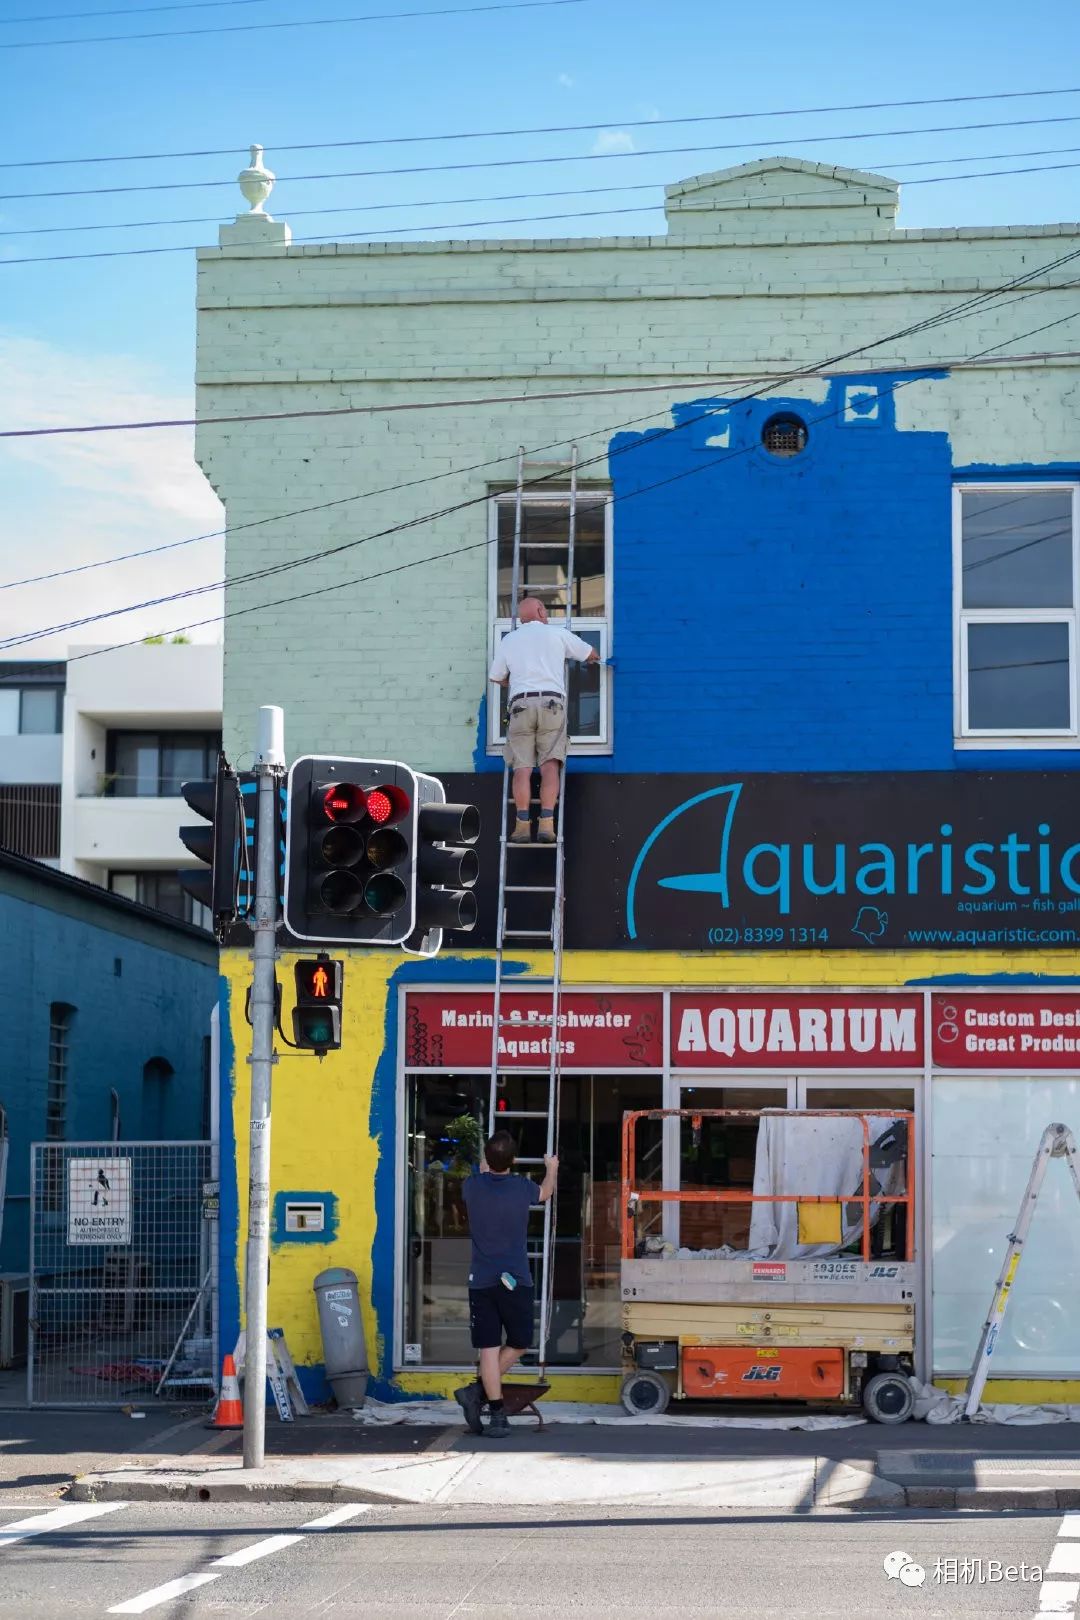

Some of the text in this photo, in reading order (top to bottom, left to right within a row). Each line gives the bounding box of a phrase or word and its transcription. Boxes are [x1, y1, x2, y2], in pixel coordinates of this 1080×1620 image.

[627, 782, 1080, 939] Aquaristic
[957, 900, 1017, 914] aquarium
[1033, 898, 1054, 912] fish
[708, 927, 829, 944] (02) 8399 1314
[965, 1008, 1035, 1027] Custom
[677, 1008, 917, 1058] AQUARIUM
[966, 1033, 1015, 1052] Great
[74, 1217, 125, 1226] NO ENTRY
[869, 1266, 899, 1278] JLG
[742, 1365, 784, 1381] JLG
[274, 1382, 291, 1420] BAILEY
